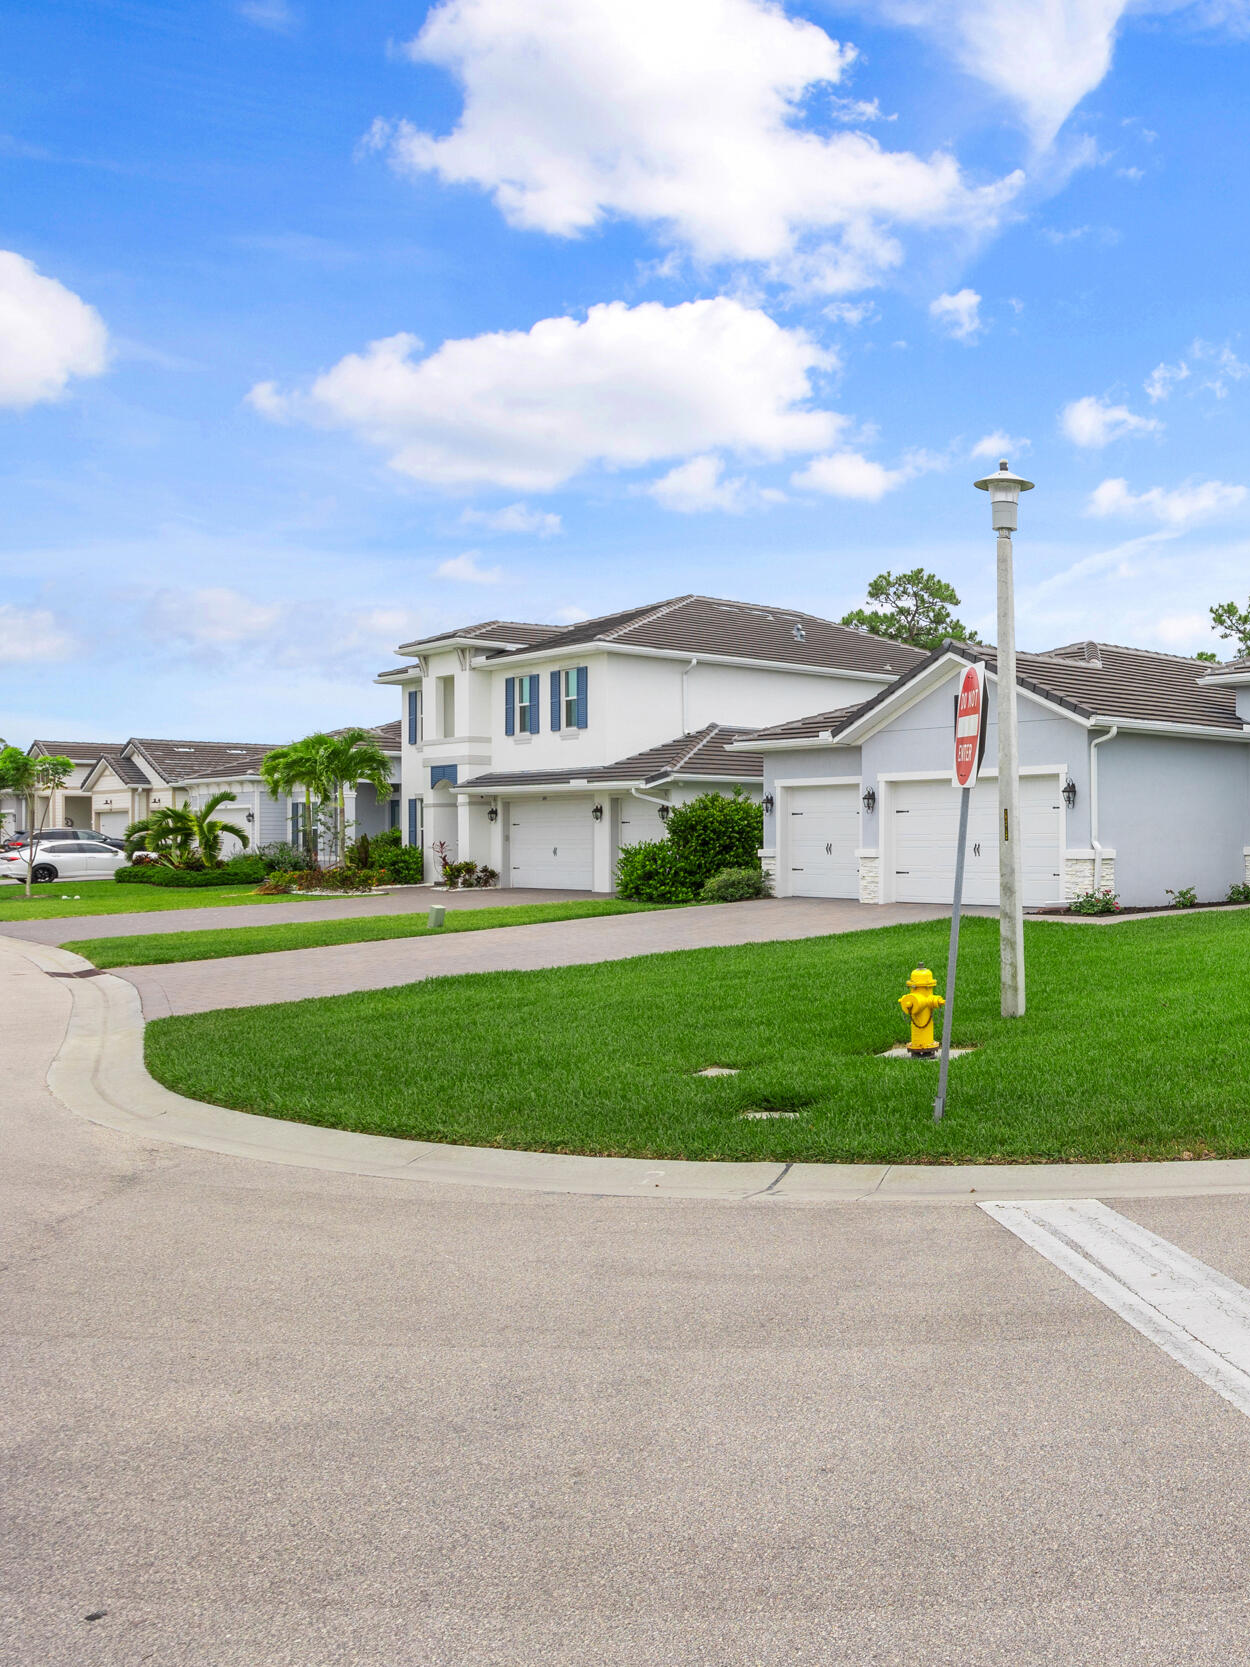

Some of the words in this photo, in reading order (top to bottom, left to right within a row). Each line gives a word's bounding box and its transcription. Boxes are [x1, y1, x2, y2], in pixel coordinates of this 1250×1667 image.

[960, 692, 967, 710] DO
[968, 689, 978, 708] NOT
[958, 743, 972, 762] ENTER
